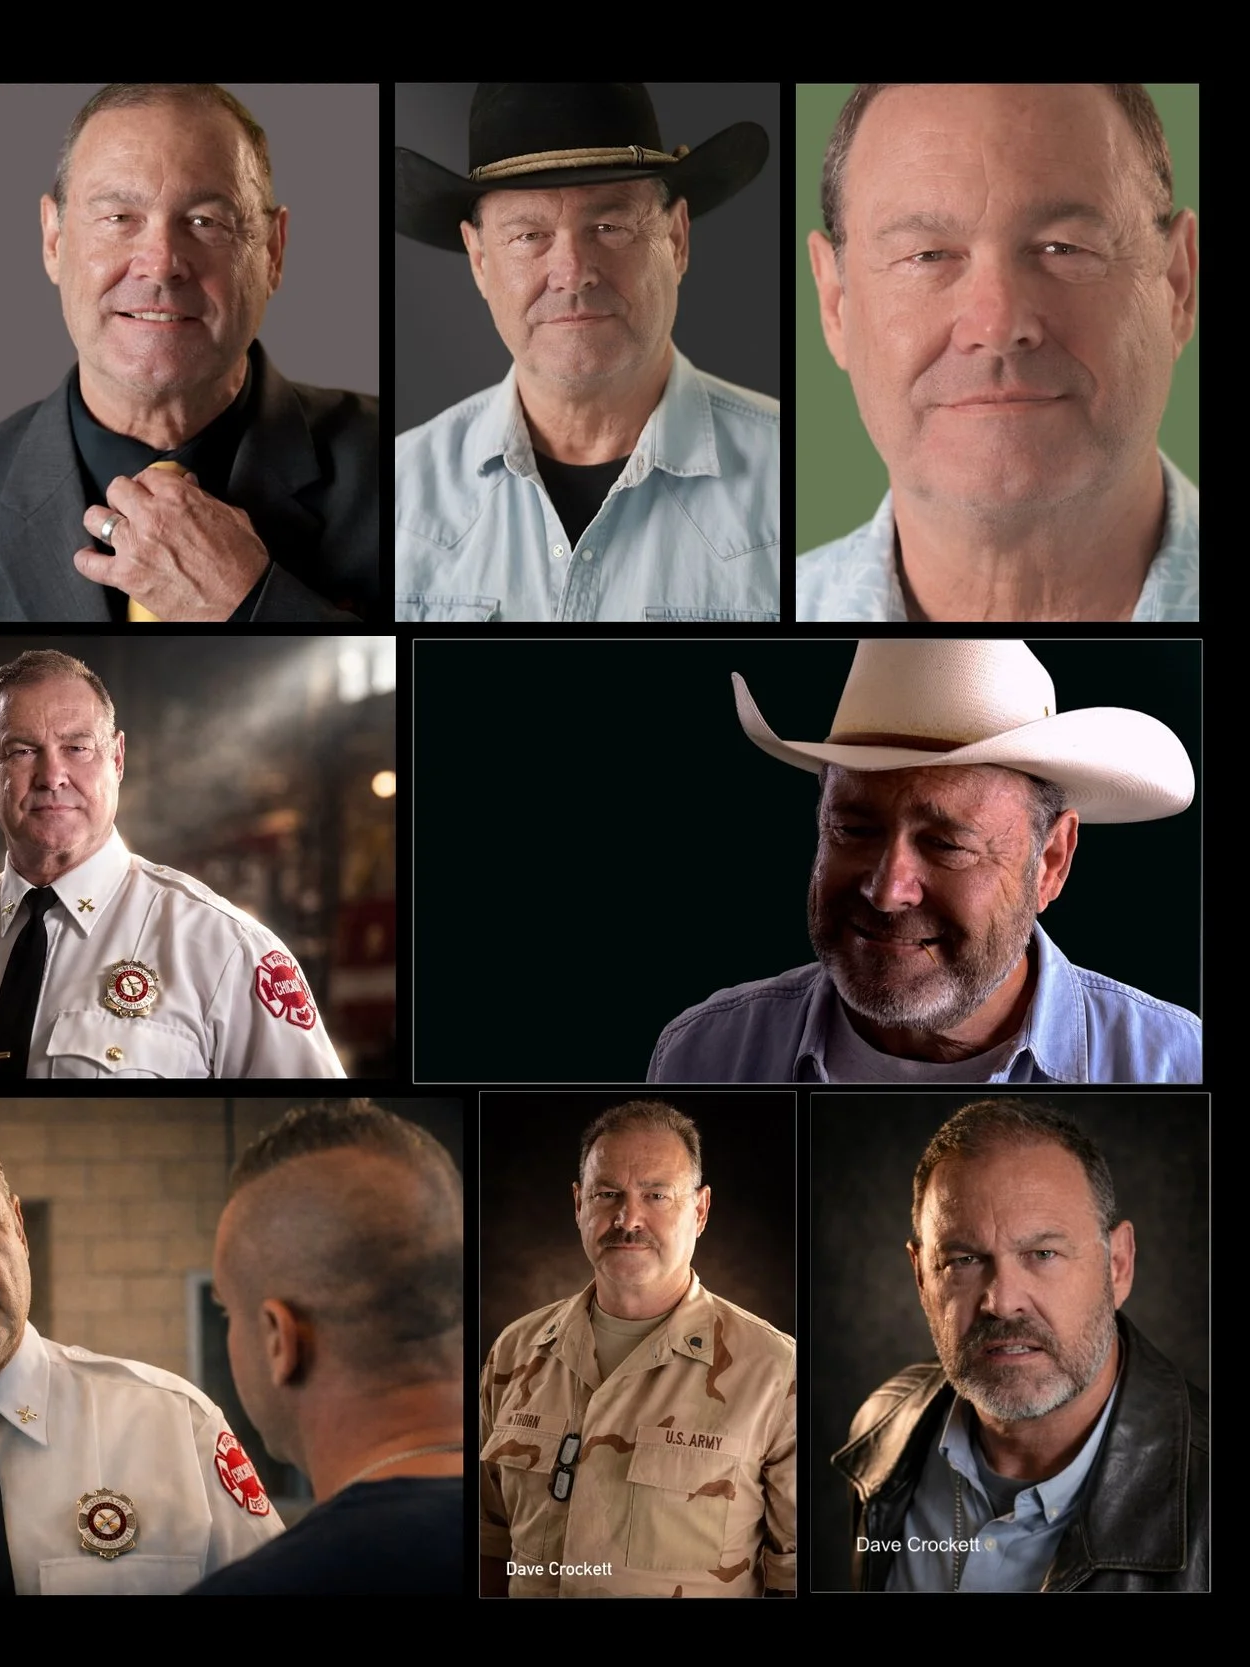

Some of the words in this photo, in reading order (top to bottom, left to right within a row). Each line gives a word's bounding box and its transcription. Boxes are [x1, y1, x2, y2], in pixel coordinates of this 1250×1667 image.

[271, 954, 288, 965] FIRE
[665, 1432, 687, 1446] U.S.
[689, 1435, 723, 1450] ARMY
[84, 1496, 128, 1511] CHICAGO
